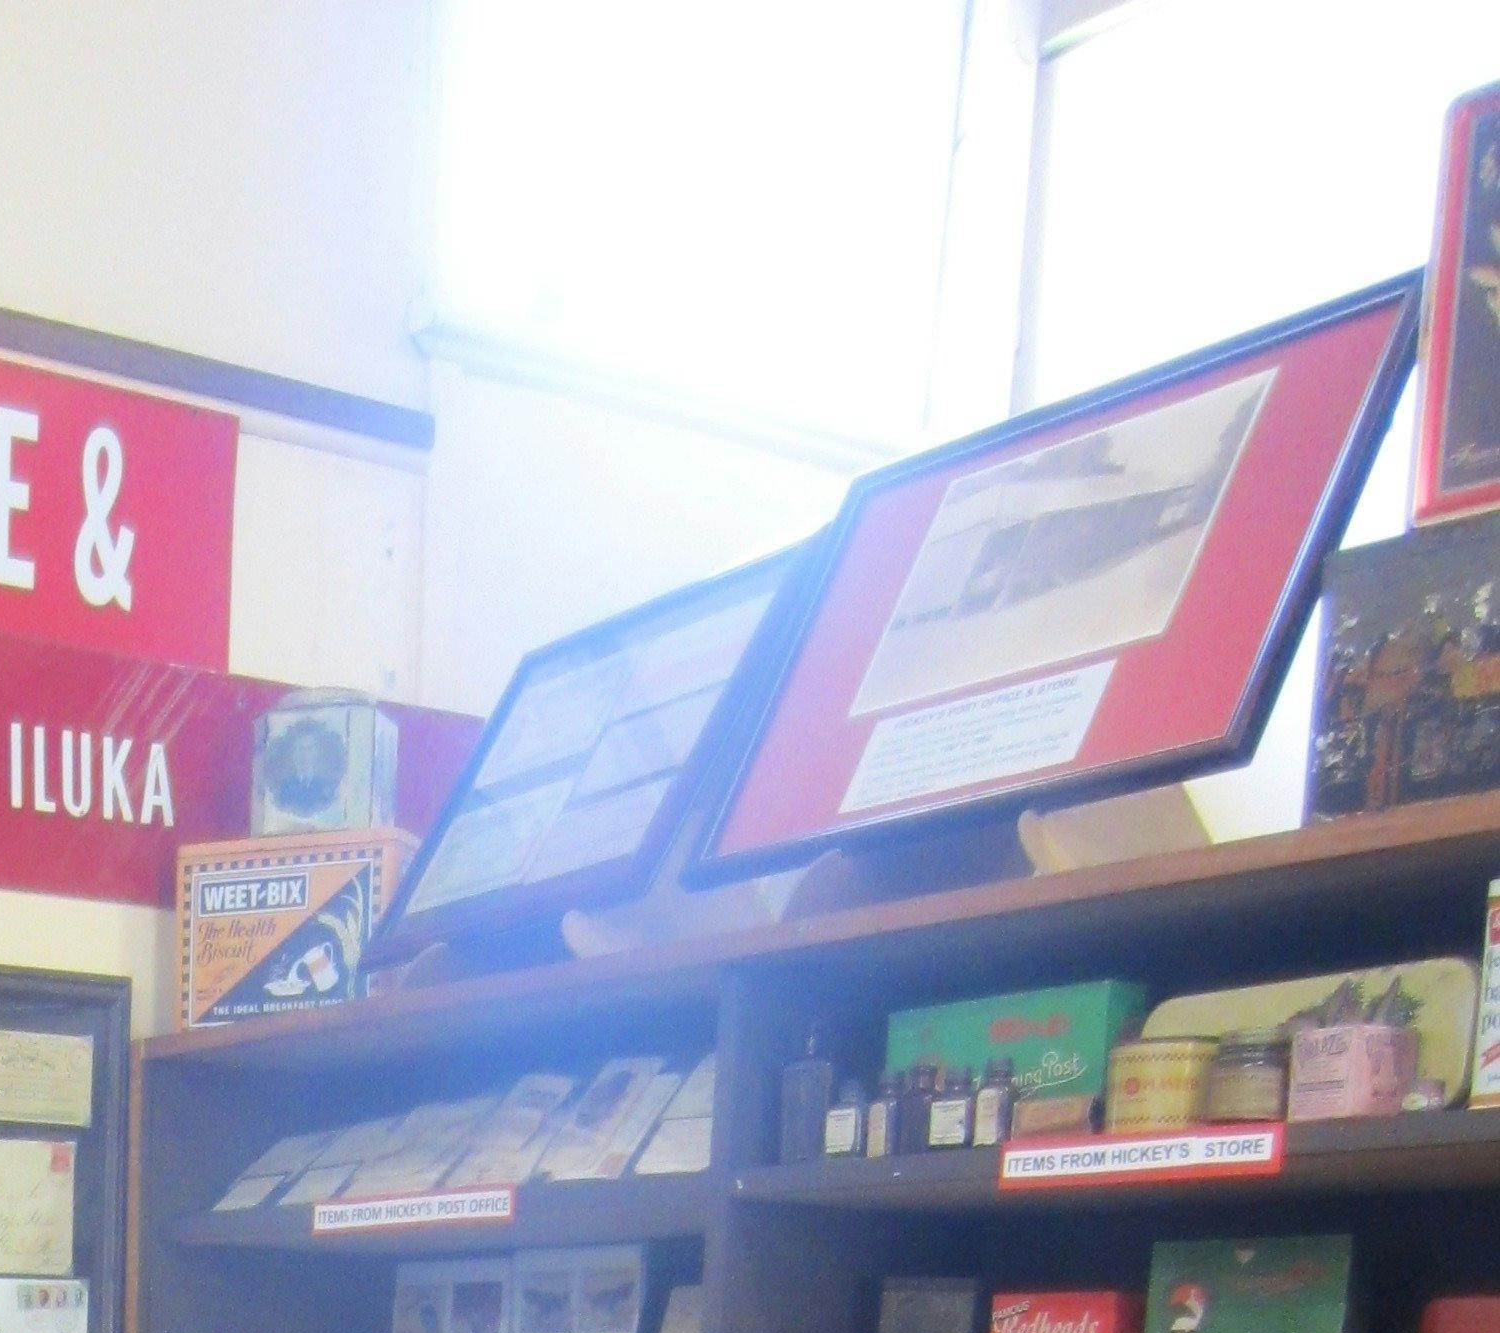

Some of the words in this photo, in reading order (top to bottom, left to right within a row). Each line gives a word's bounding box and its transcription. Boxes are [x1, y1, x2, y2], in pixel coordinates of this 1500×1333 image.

[74, 426, 136, 613] &
[9, 722, 174, 828] ILUKA
[203, 880, 303, 911] WEET-BIX
[1042, 1050, 1080, 1079] Post
[1007, 1152, 1055, 1173] ITEMS
[1060, 1148, 1106, 1170] FROM
[1110, 1142, 1190, 1167] HICKEY'S
[1204, 1138, 1265, 1159] STORE
[318, 1209, 349, 1225] ITEMS
[352, 1206, 384, 1222] FROM
[437, 1199, 466, 1215] POST
[469, 1196, 509, 1213] OFFICE
